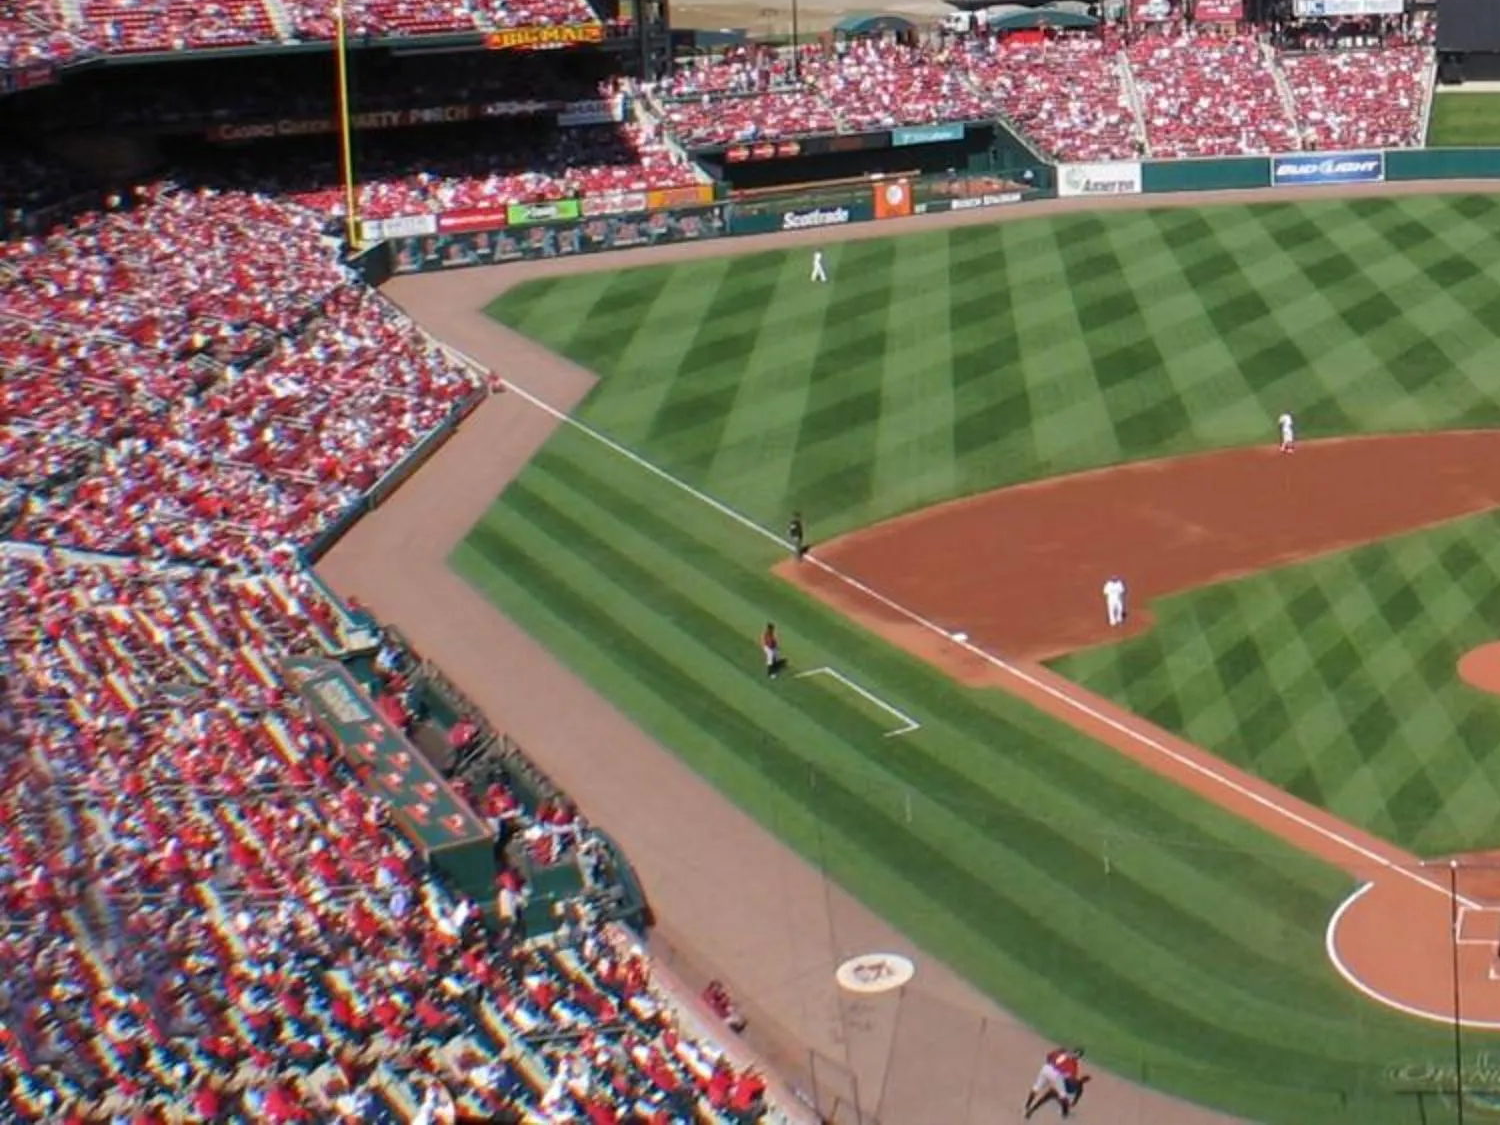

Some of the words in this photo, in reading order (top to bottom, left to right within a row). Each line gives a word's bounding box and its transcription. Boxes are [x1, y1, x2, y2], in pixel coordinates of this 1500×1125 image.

[503, 32, 537, 48] BIG
[346, 109, 400, 129] ARTY
[1276, 162, 1319, 176] BUD
[1328, 160, 1379, 175] LIGHT
[783, 206, 848, 229] Scottrade
